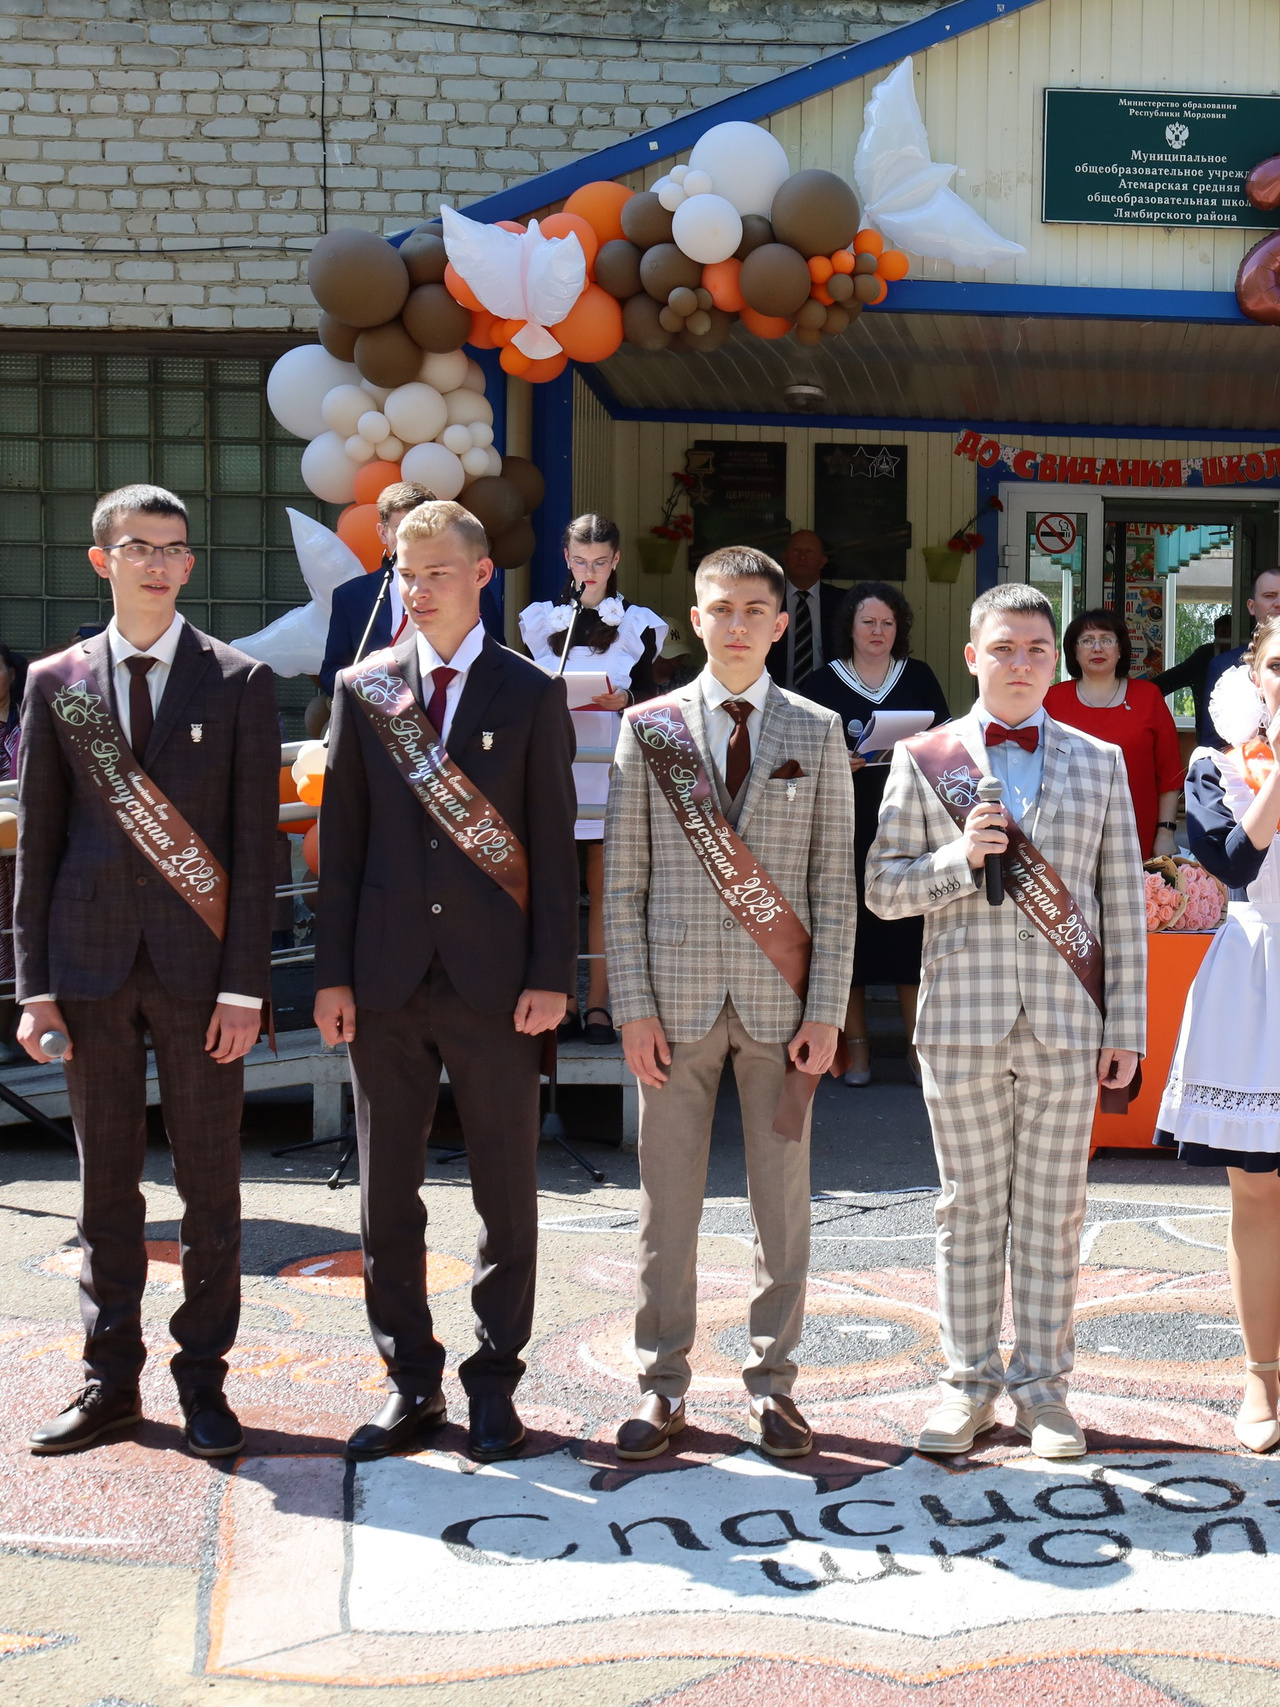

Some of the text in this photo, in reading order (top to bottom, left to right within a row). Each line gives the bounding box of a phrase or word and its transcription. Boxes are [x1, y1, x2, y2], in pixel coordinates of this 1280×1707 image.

[1118, 98, 1237, 110] Министерство образования
[1129, 108, 1226, 120] Республики Мордовия
[1130, 149, 1227, 164] Муниципальное
[1074, 162, 1204, 178] общеобразовательное
[1118, 178, 1240, 194] Атемарская средняя
[1087, 192, 1217, 207] общеобразовательная
[1114, 208, 1237, 222] Лямбирского района
[954, 428, 1002, 468] ДО
[1012, 449, 1183, 487] СВИДАНИЯ
[389, 716, 513, 862] Выпускник 2025
[90, 739, 218, 893] Выпускник 2025
[153, 802, 169, 820] Егор
[669, 764, 782, 923] Выпускник 2025
[1030, 862, 1059, 895] Дмитрий
[1055, 913, 1092, 958] 2025
